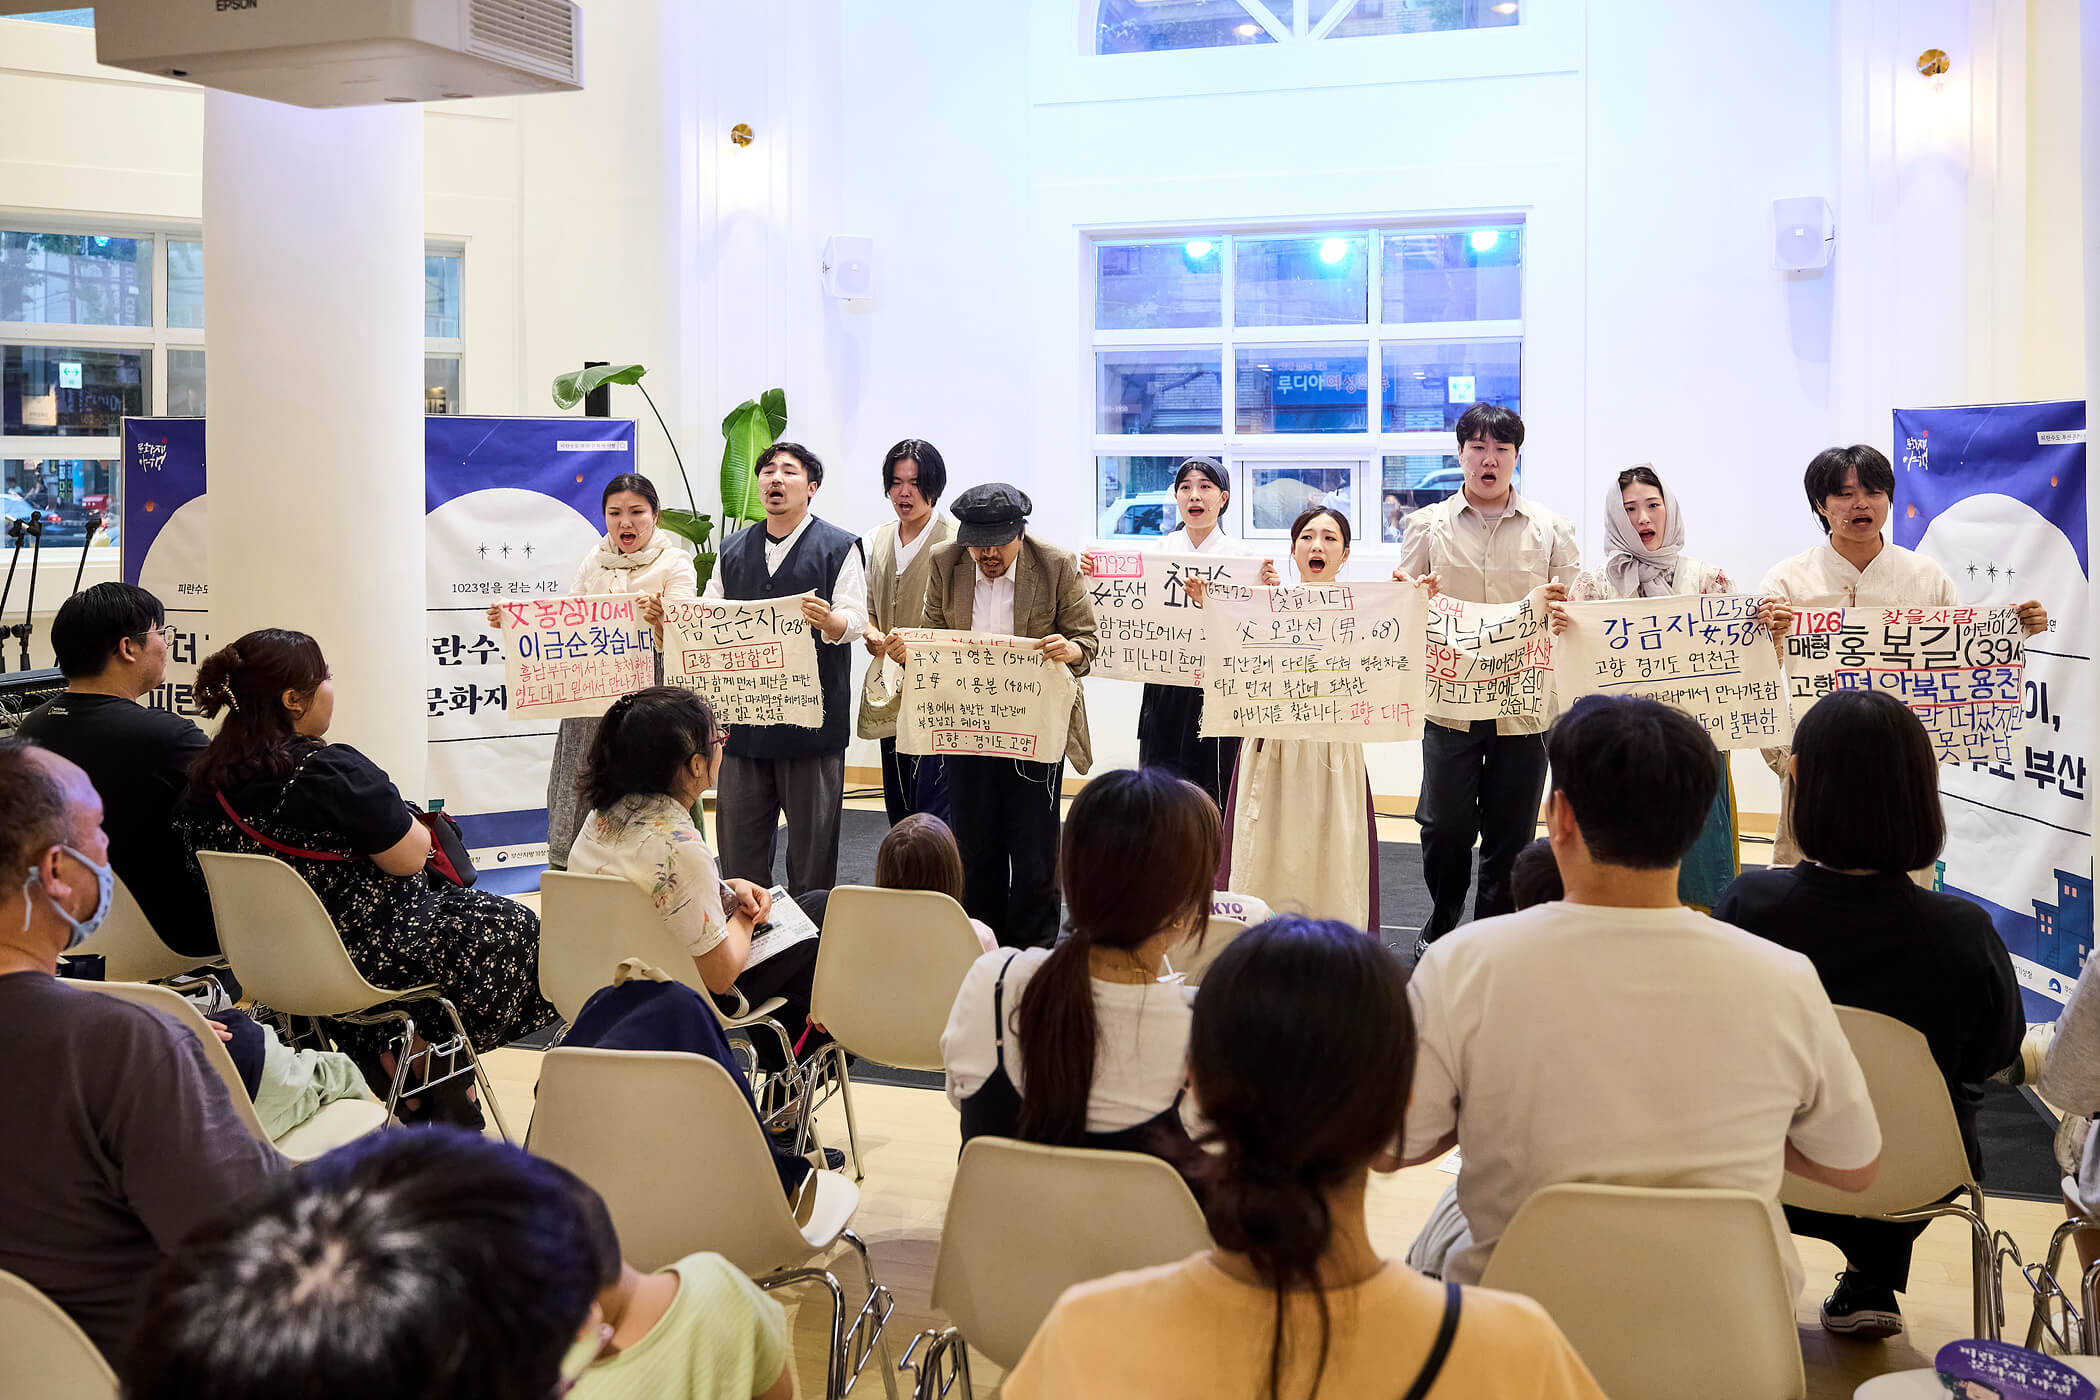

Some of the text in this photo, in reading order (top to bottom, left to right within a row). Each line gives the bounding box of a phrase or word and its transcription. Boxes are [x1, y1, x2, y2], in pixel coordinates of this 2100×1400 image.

[215, 0, 257, 12] EPSON
[1277, 374, 1324, 395] 루디아
[452, 580, 559, 594] 1023일을 걷는 시간
[1099, 615, 1193, 643] 함경남도에서
[1270, 616, 1327, 645] 오광선
[1602, 612, 1700, 650] 강금자
[427, 634, 506, 666] 란수
[688, 645, 778, 670] 고향 경남함안
[952, 648, 996, 666] 김영춘
[1787, 634, 1831, 660] 매형
[1836, 624, 1961, 671] 홍복길
[1223, 655, 1273, 674] 피난길에
[1595, 650, 1741, 678] 고향 경기도 연천군
[737, 676, 756, 691] 먼저
[1245, 679, 1272, 698] 먼저
[1791, 673, 1835, 698] 고향
[916, 701, 955, 716] 서울에서
[1233, 702, 1284, 727] 아버지를
[1350, 700, 1376, 725] 고향
[1381, 702, 1415, 727] 대구
[918, 716, 956, 729] 부모님과
[936, 732, 959, 749] 고향
[973, 734, 1007, 749] 경기도
[1010, 736, 1032, 752] 고양
[2024, 745, 2087, 801] 부산
